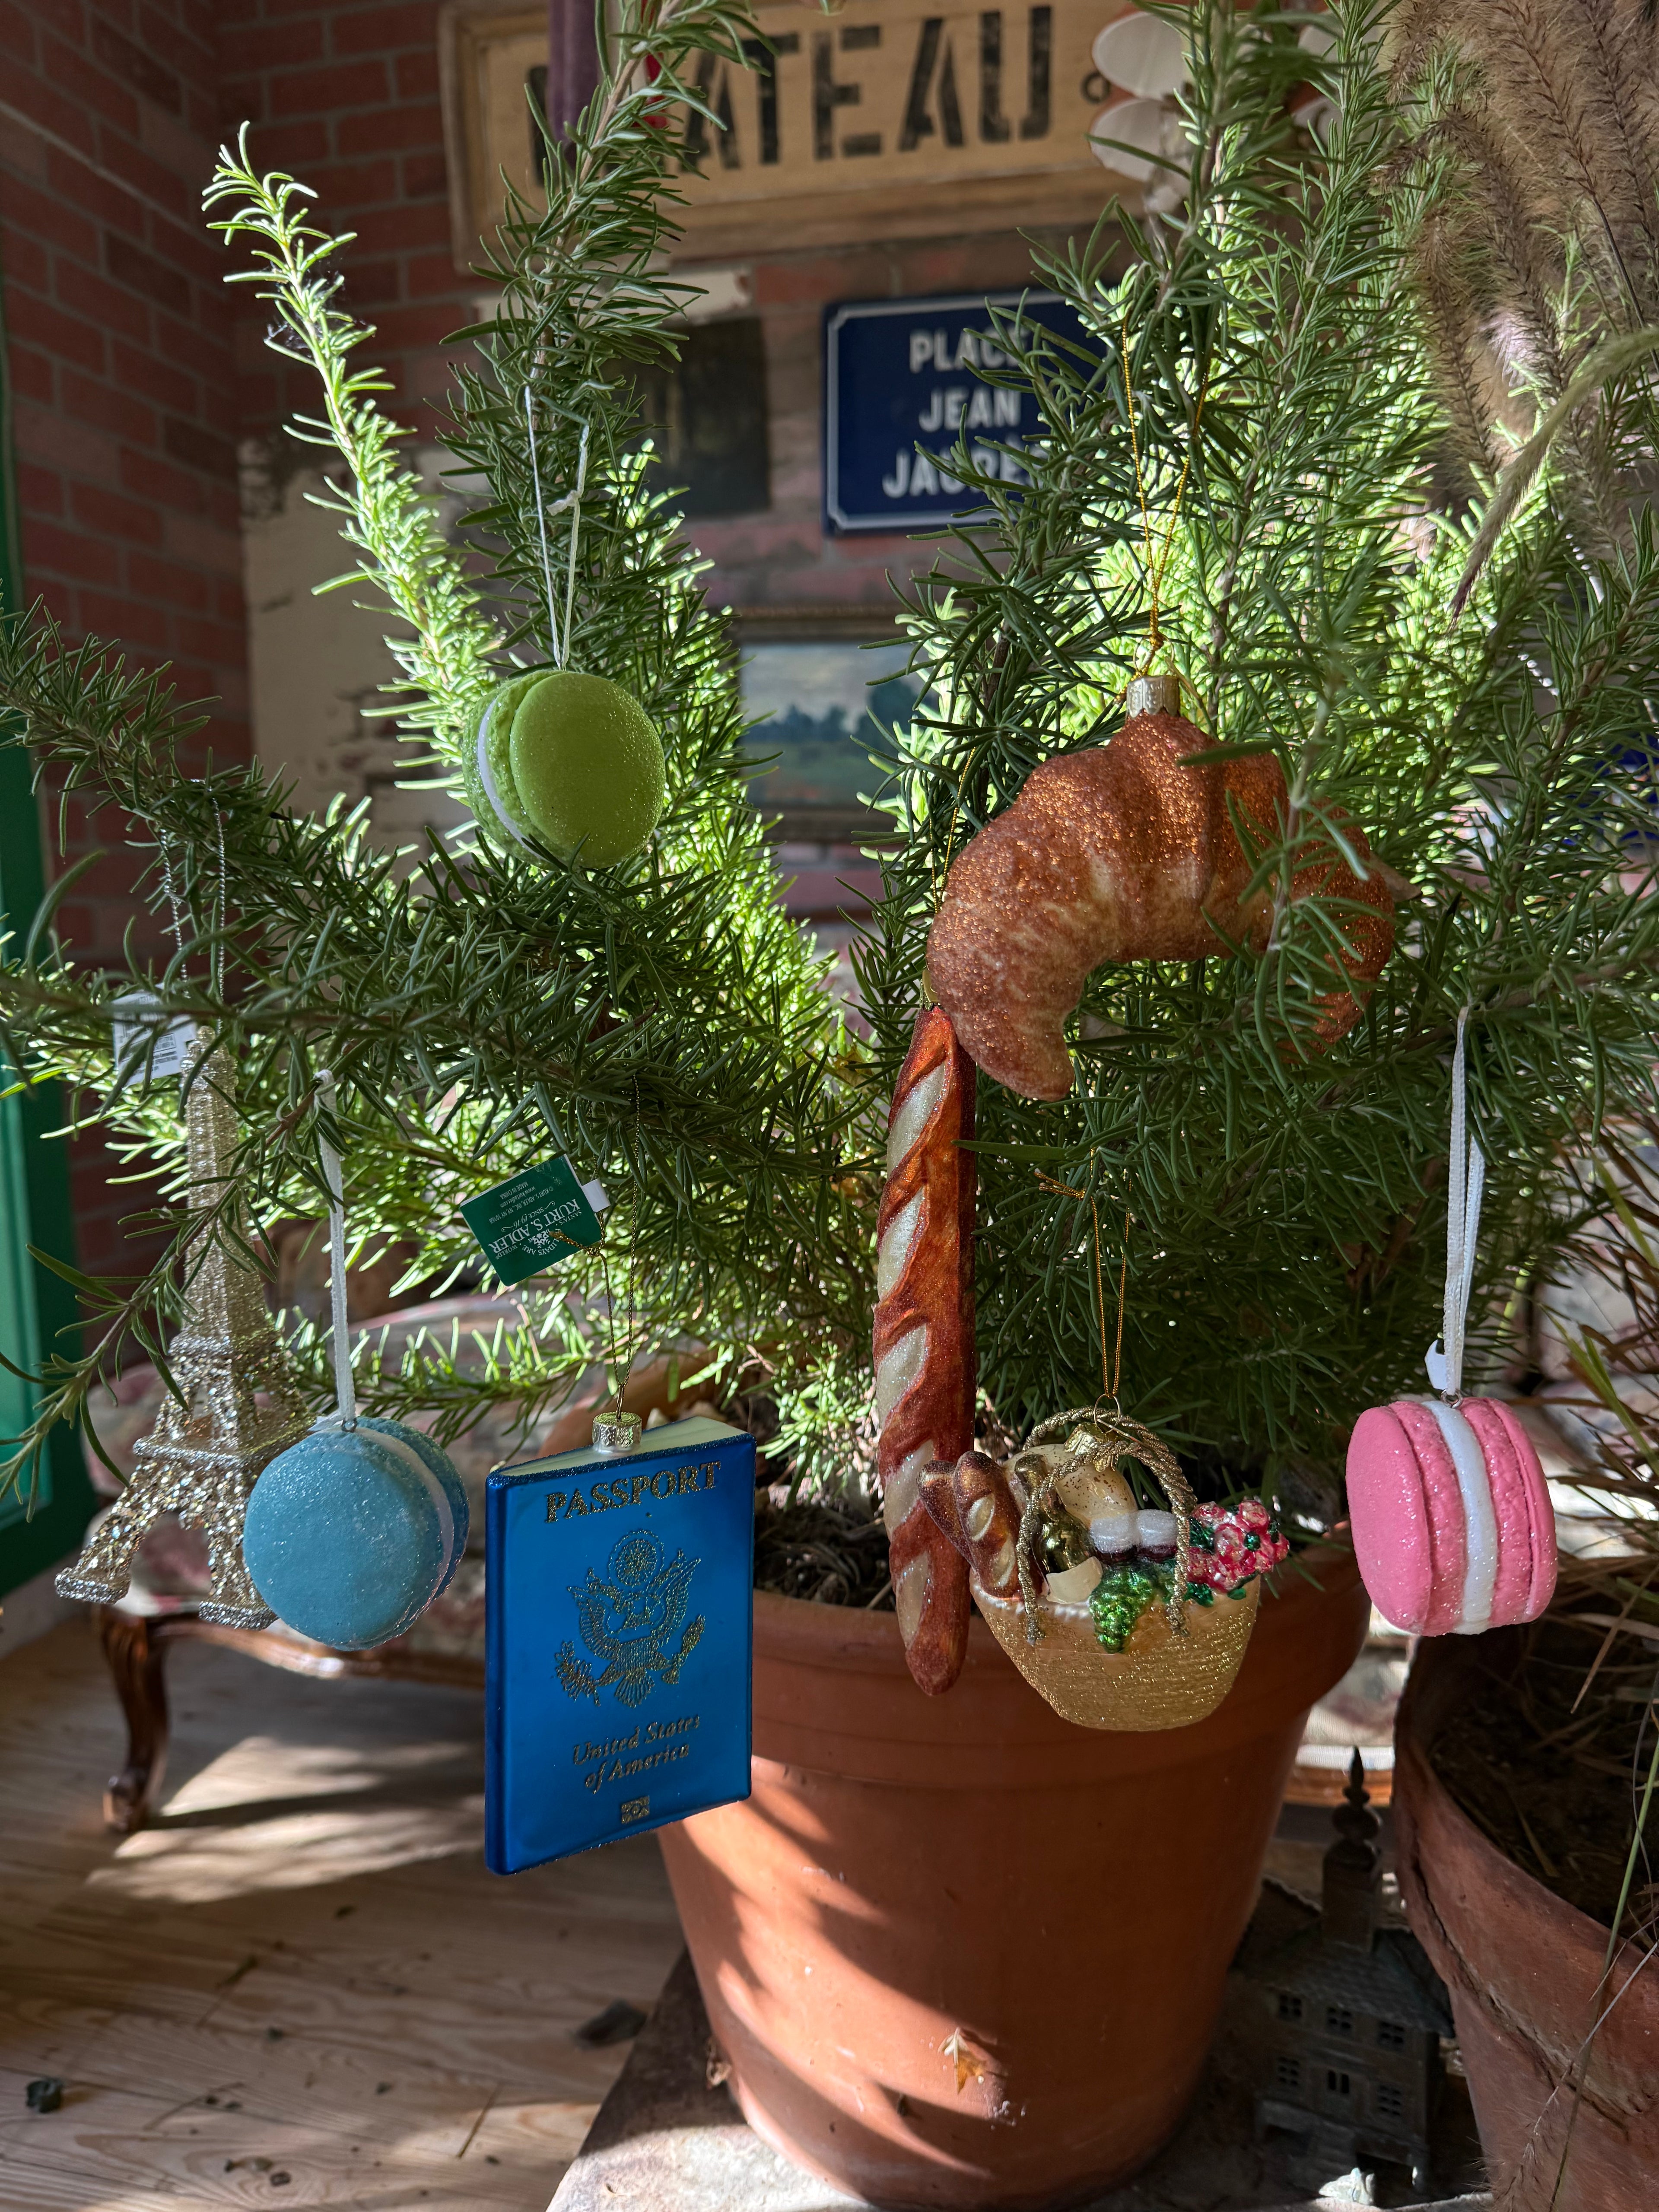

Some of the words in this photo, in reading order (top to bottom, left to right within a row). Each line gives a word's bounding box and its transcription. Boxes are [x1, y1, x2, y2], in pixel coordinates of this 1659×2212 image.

[527, 6, 1055, 187] ATEAU
[918, 387, 1021, 432] JEAN
[499, 1189, 513, 1200] CHINA
[516, 1181, 528, 1191] MADE
[528, 1207, 544, 1219] SINCE
[530, 1218, 544, 1231] S.
[543, 1198, 581, 1227] KURT
[559, 1210, 582, 1225] SANTA'S
[488, 1224, 530, 1254] ADLER
[546, 1461, 721, 1523] PASSPORT
[573, 1726, 641, 1766] United
[645, 1714, 701, 1743] States
[585, 1761, 607, 1796] of
[607, 1744, 690, 1782] America
